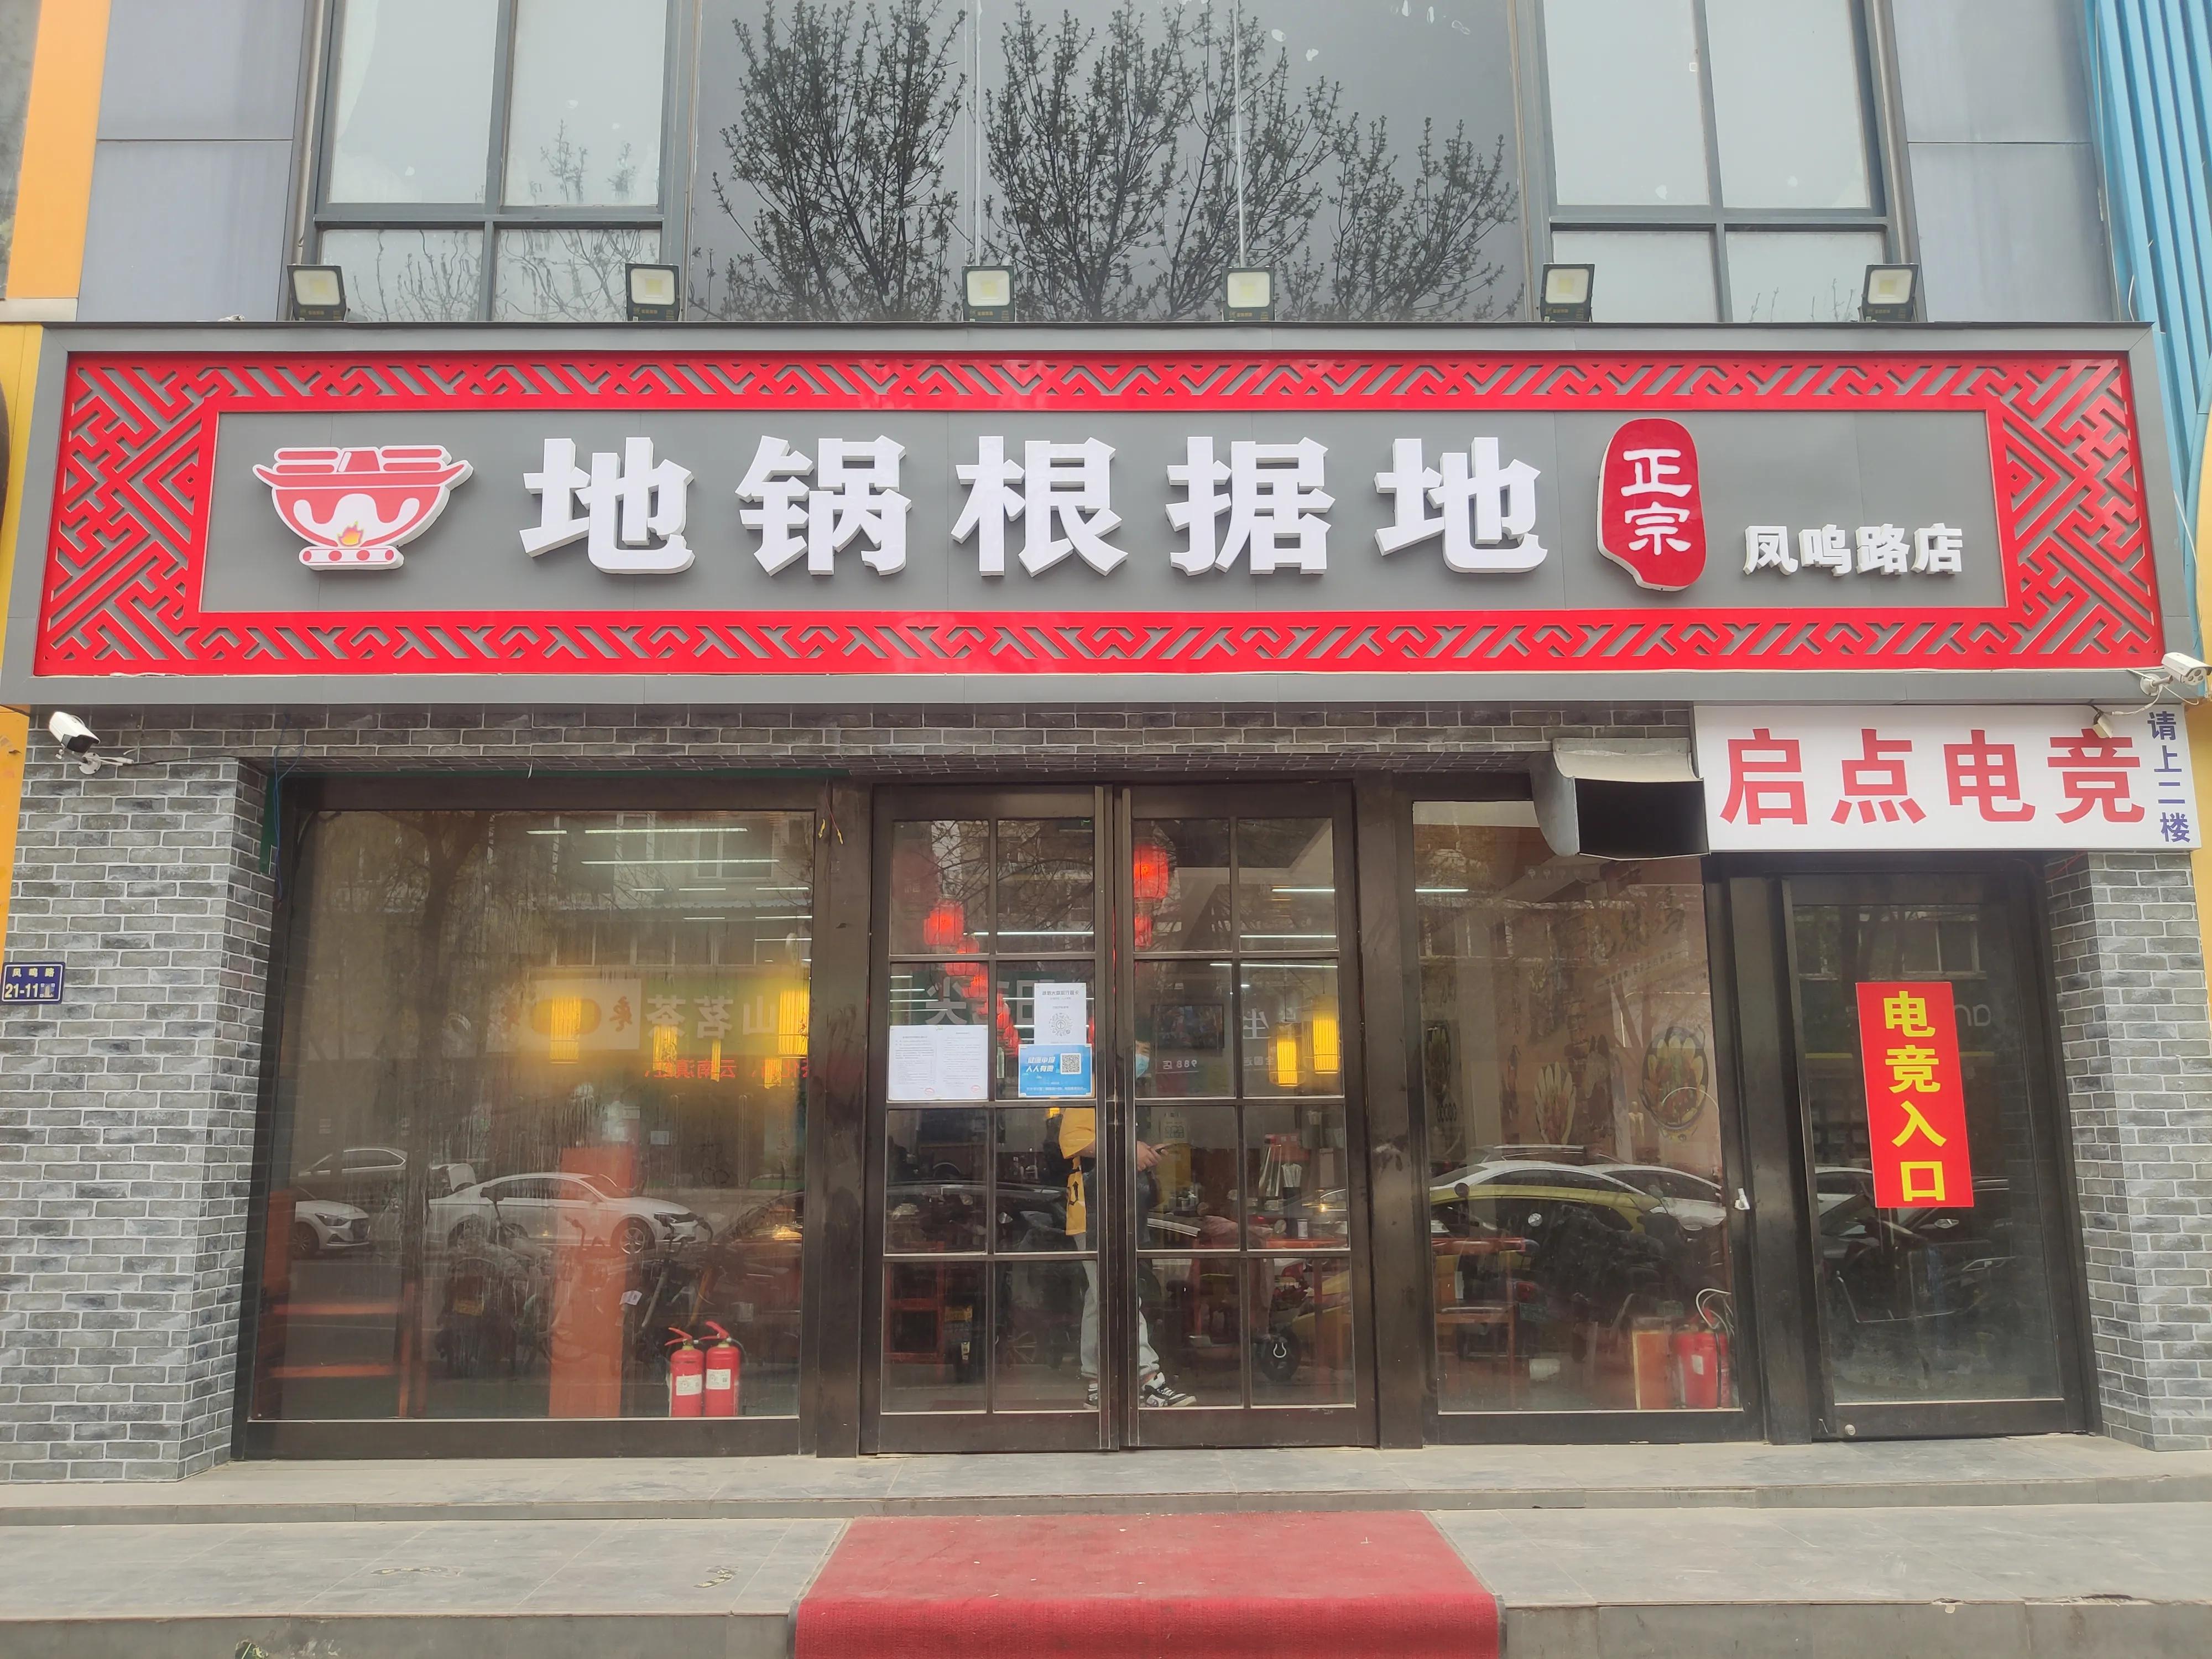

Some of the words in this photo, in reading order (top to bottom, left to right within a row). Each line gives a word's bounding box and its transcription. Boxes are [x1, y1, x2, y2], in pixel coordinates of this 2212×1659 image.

[519, 434, 1548, 576] 地锅根据地
[1620, 448, 1693, 556] 正宗
[1743, 523, 1963, 577] 凤鸣路店
[1719, 728, 2146, 825] 启点电竞
[2147, 711, 2190, 843] 请上二楼
[4, 983, 39, 998] 21-11
[1882, 990, 1947, 1202] 电竞入口
